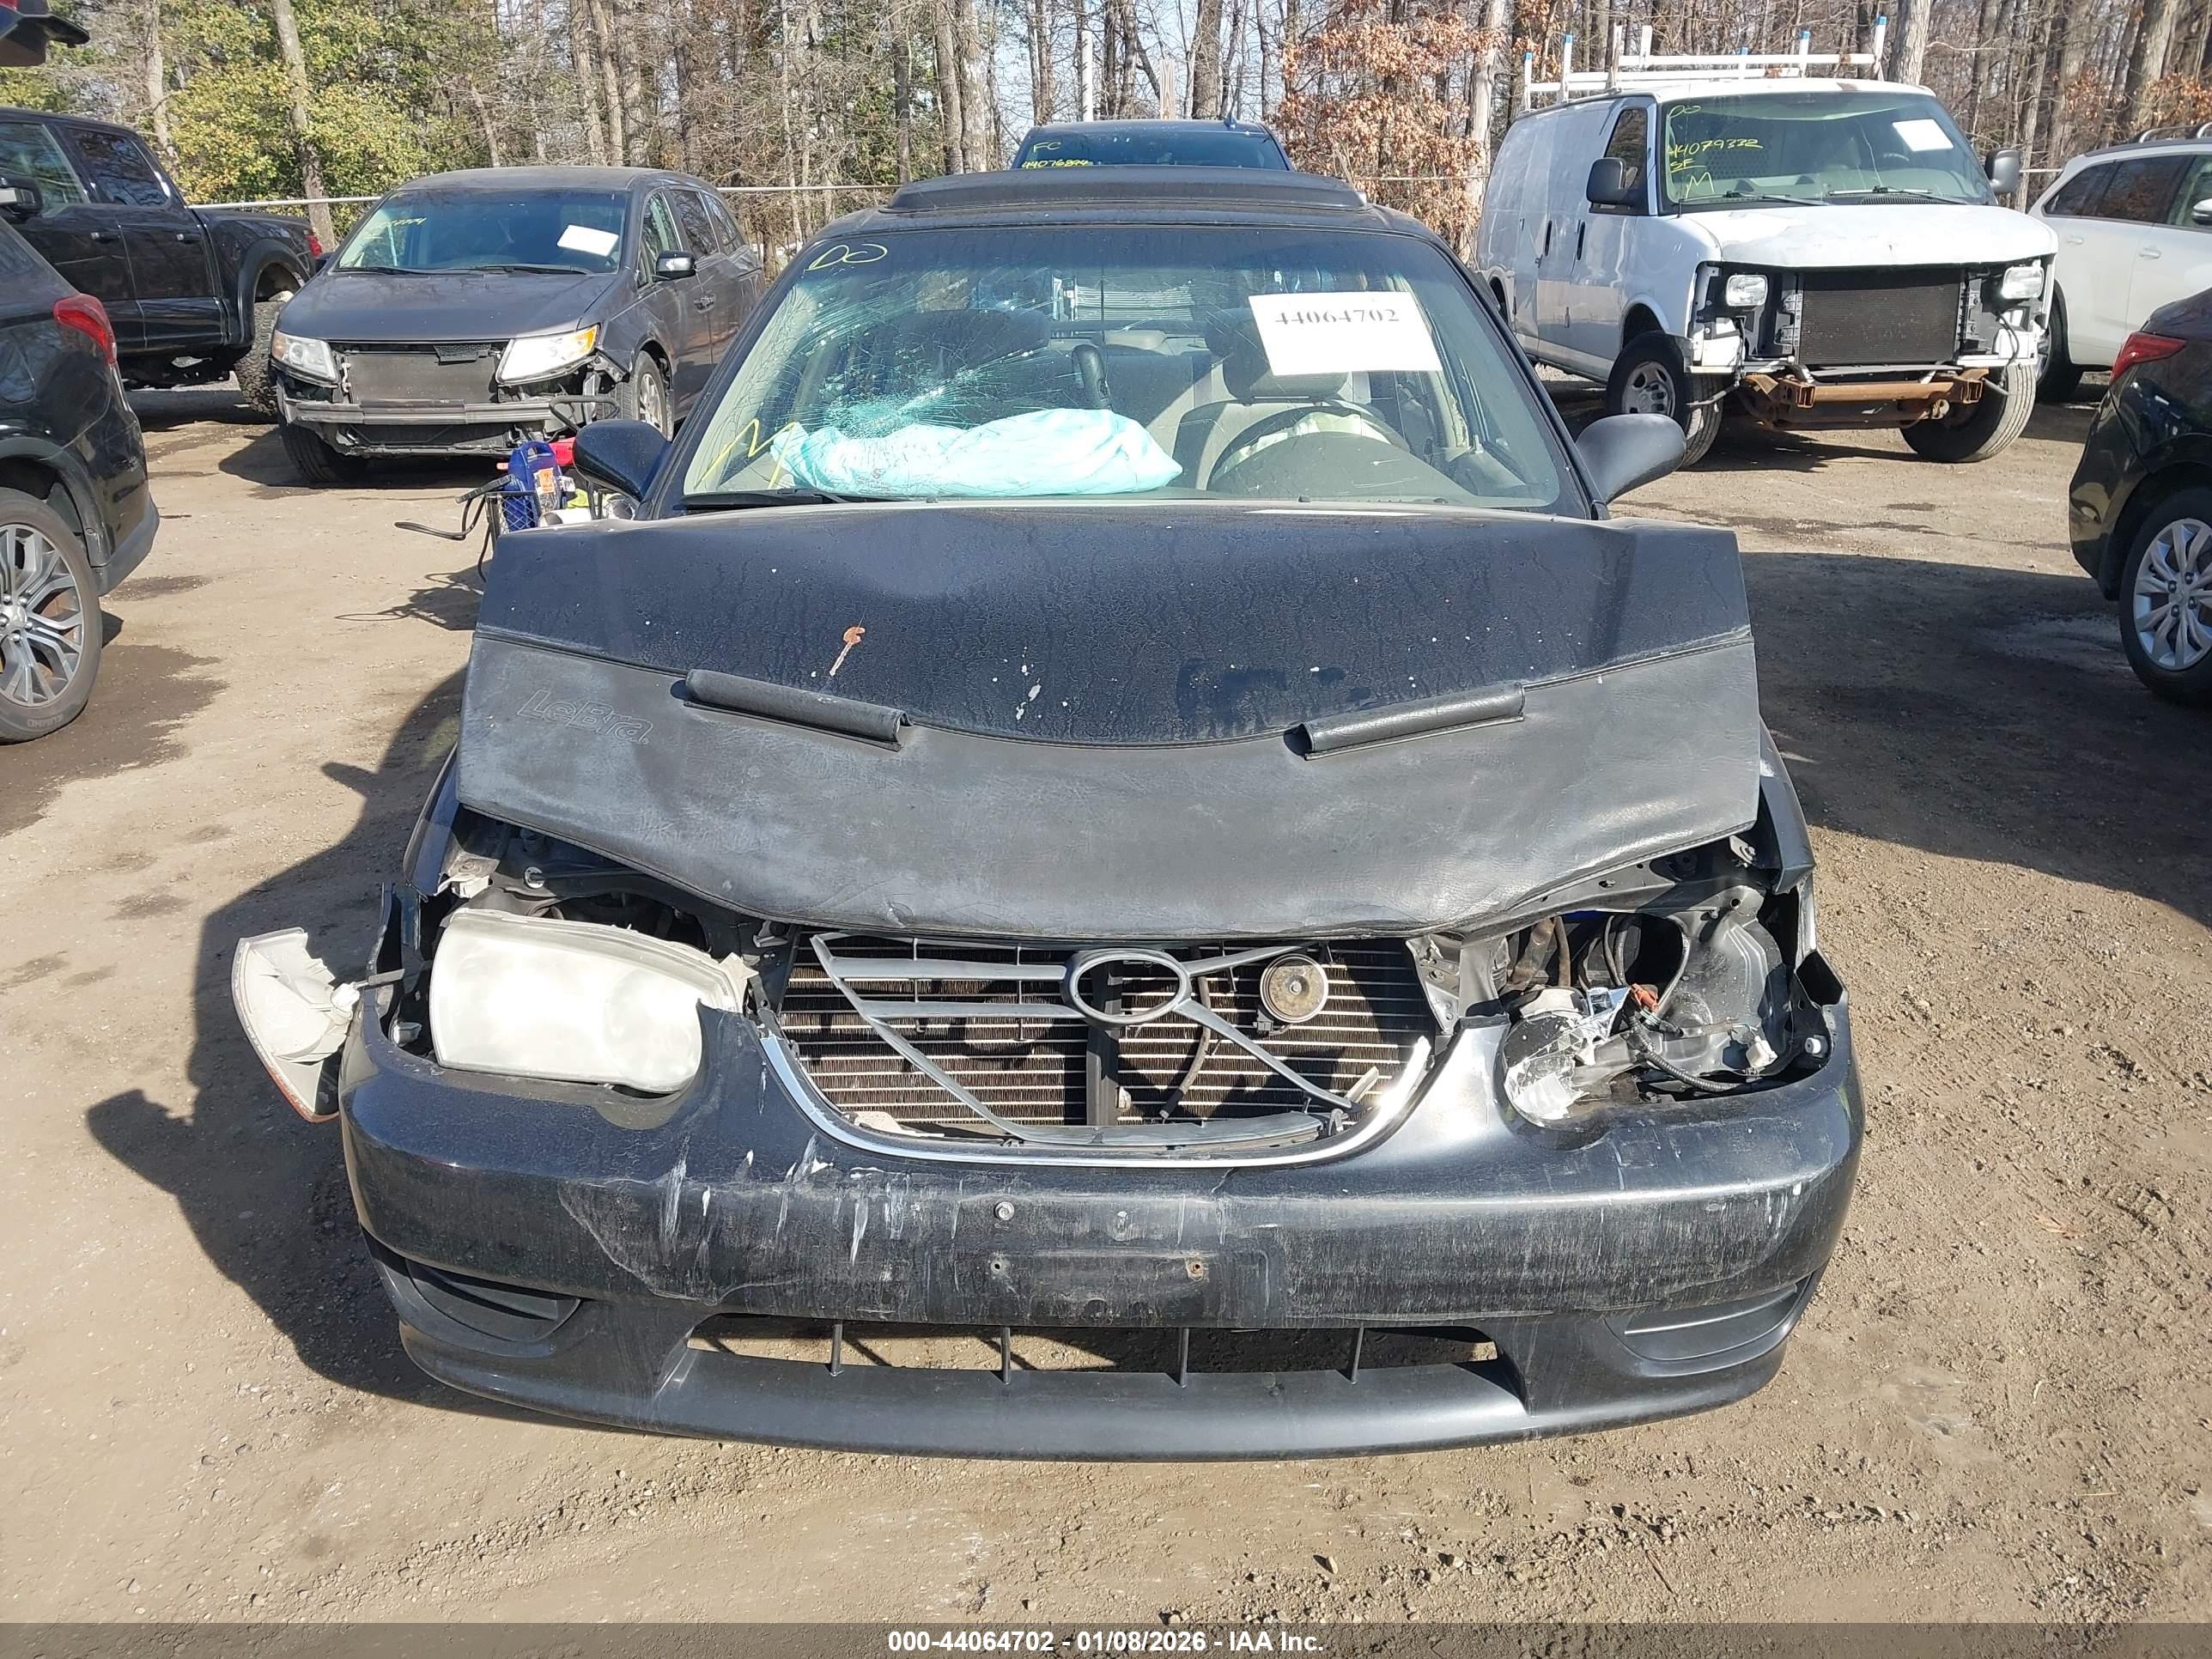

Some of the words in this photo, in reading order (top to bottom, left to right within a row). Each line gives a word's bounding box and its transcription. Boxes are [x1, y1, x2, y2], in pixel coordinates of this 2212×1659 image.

[1033, 142, 1062, 153] FC
[1275, 308, 1400, 325] 44064702
[517, 690, 653, 744] LeBra
